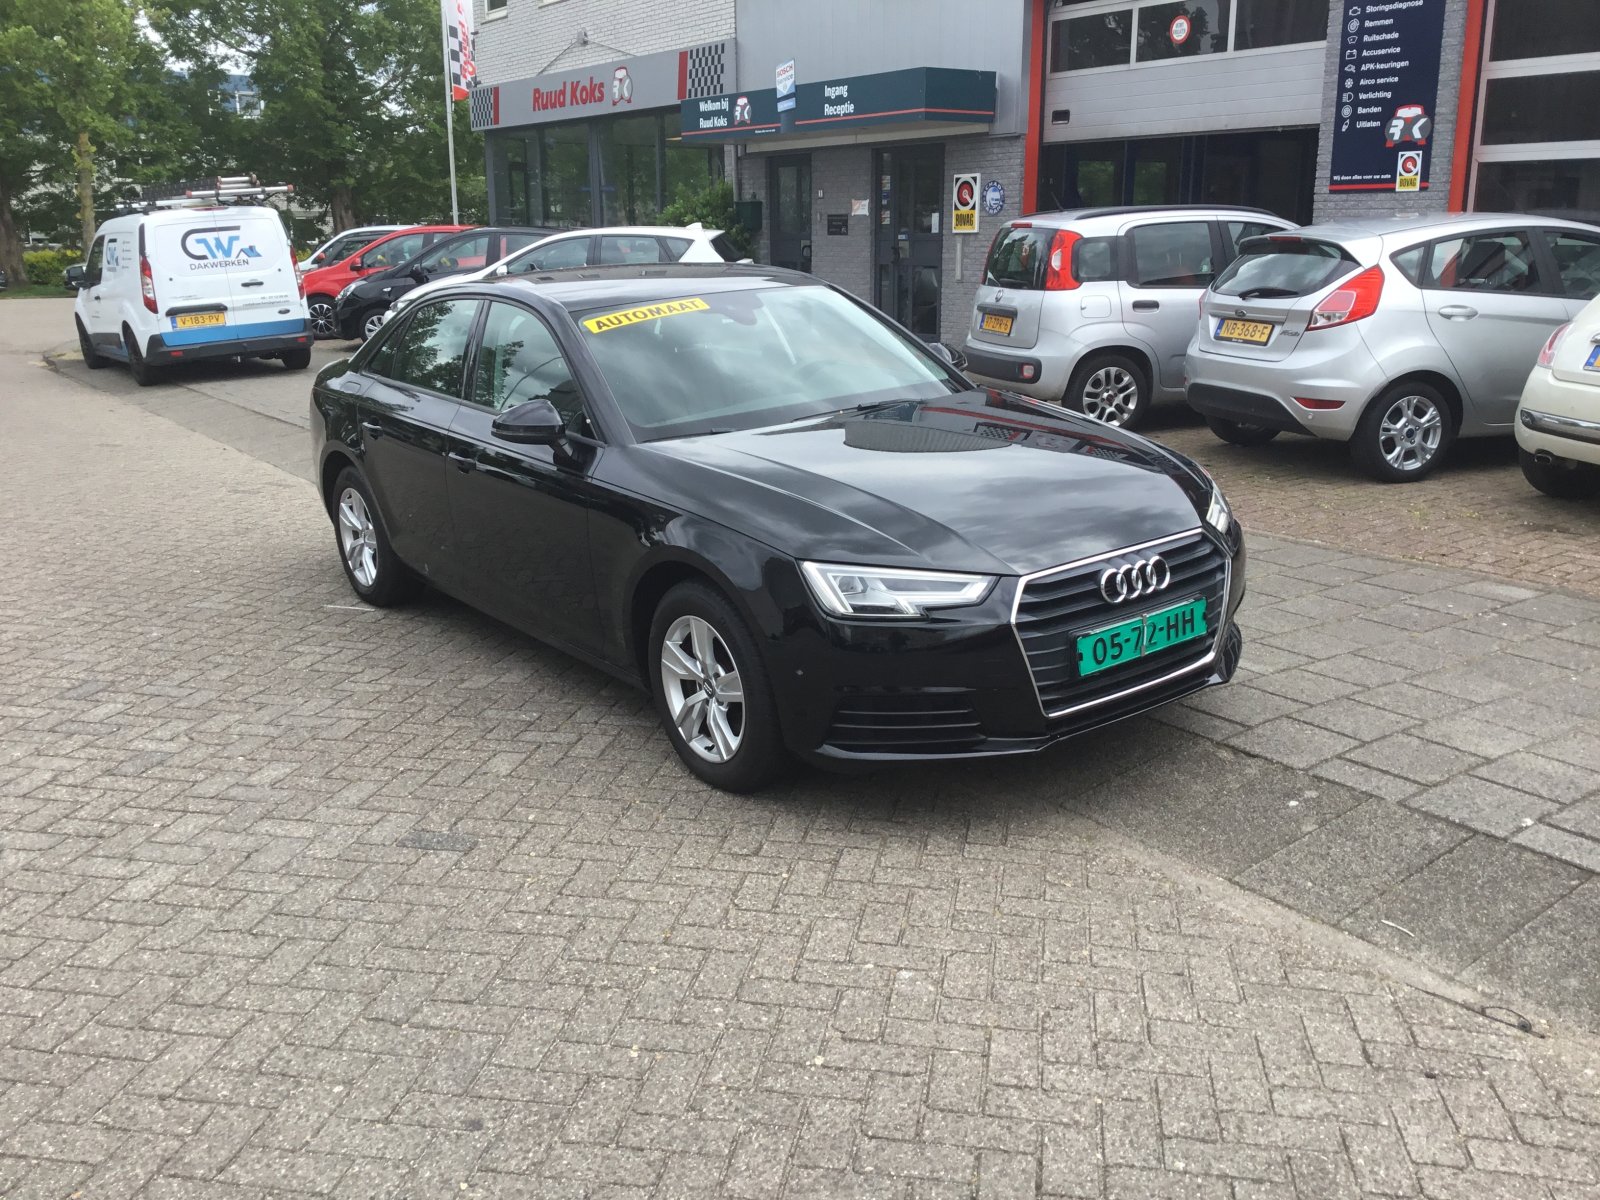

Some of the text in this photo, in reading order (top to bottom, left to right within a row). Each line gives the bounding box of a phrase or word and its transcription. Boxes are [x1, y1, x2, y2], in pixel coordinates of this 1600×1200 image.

[1366, 0, 1423, 13] Storingsdiagnose
[1364, 19, 1393, 27] Remmen
[1363, 32, 1399, 42] Ruitschade
[1362, 46, 1401, 56] Accuservice
[1361, 60, 1409, 71] APK-keuringen
[1376, 76, 1398, 84] service
[533, 76, 604, 112] Ruud Koks
[824, 85, 848, 98] Ingang
[1359, 91, 1392, 99] Verlichting
[699, 98, 729, 112] Welkom bij
[824, 101, 854, 116] Receptie
[1357, 106, 1381, 114] Banden
[699, 116, 728, 128] Ruud Koks
[1356, 120, 1380, 128] Uitlaten
[1399, 178, 1417, 187] BOVAG
[955, 213, 974, 227] BOVAG
[189, 259, 249, 271] DAKWERKEN
[180, 314, 221, 326] V-183-PV
[595, 300, 701, 330] AUTOMAAT
[1224, 322, 1268, 339] NB-368-F
[1093, 608, 1194, 665] 05-72-HH
